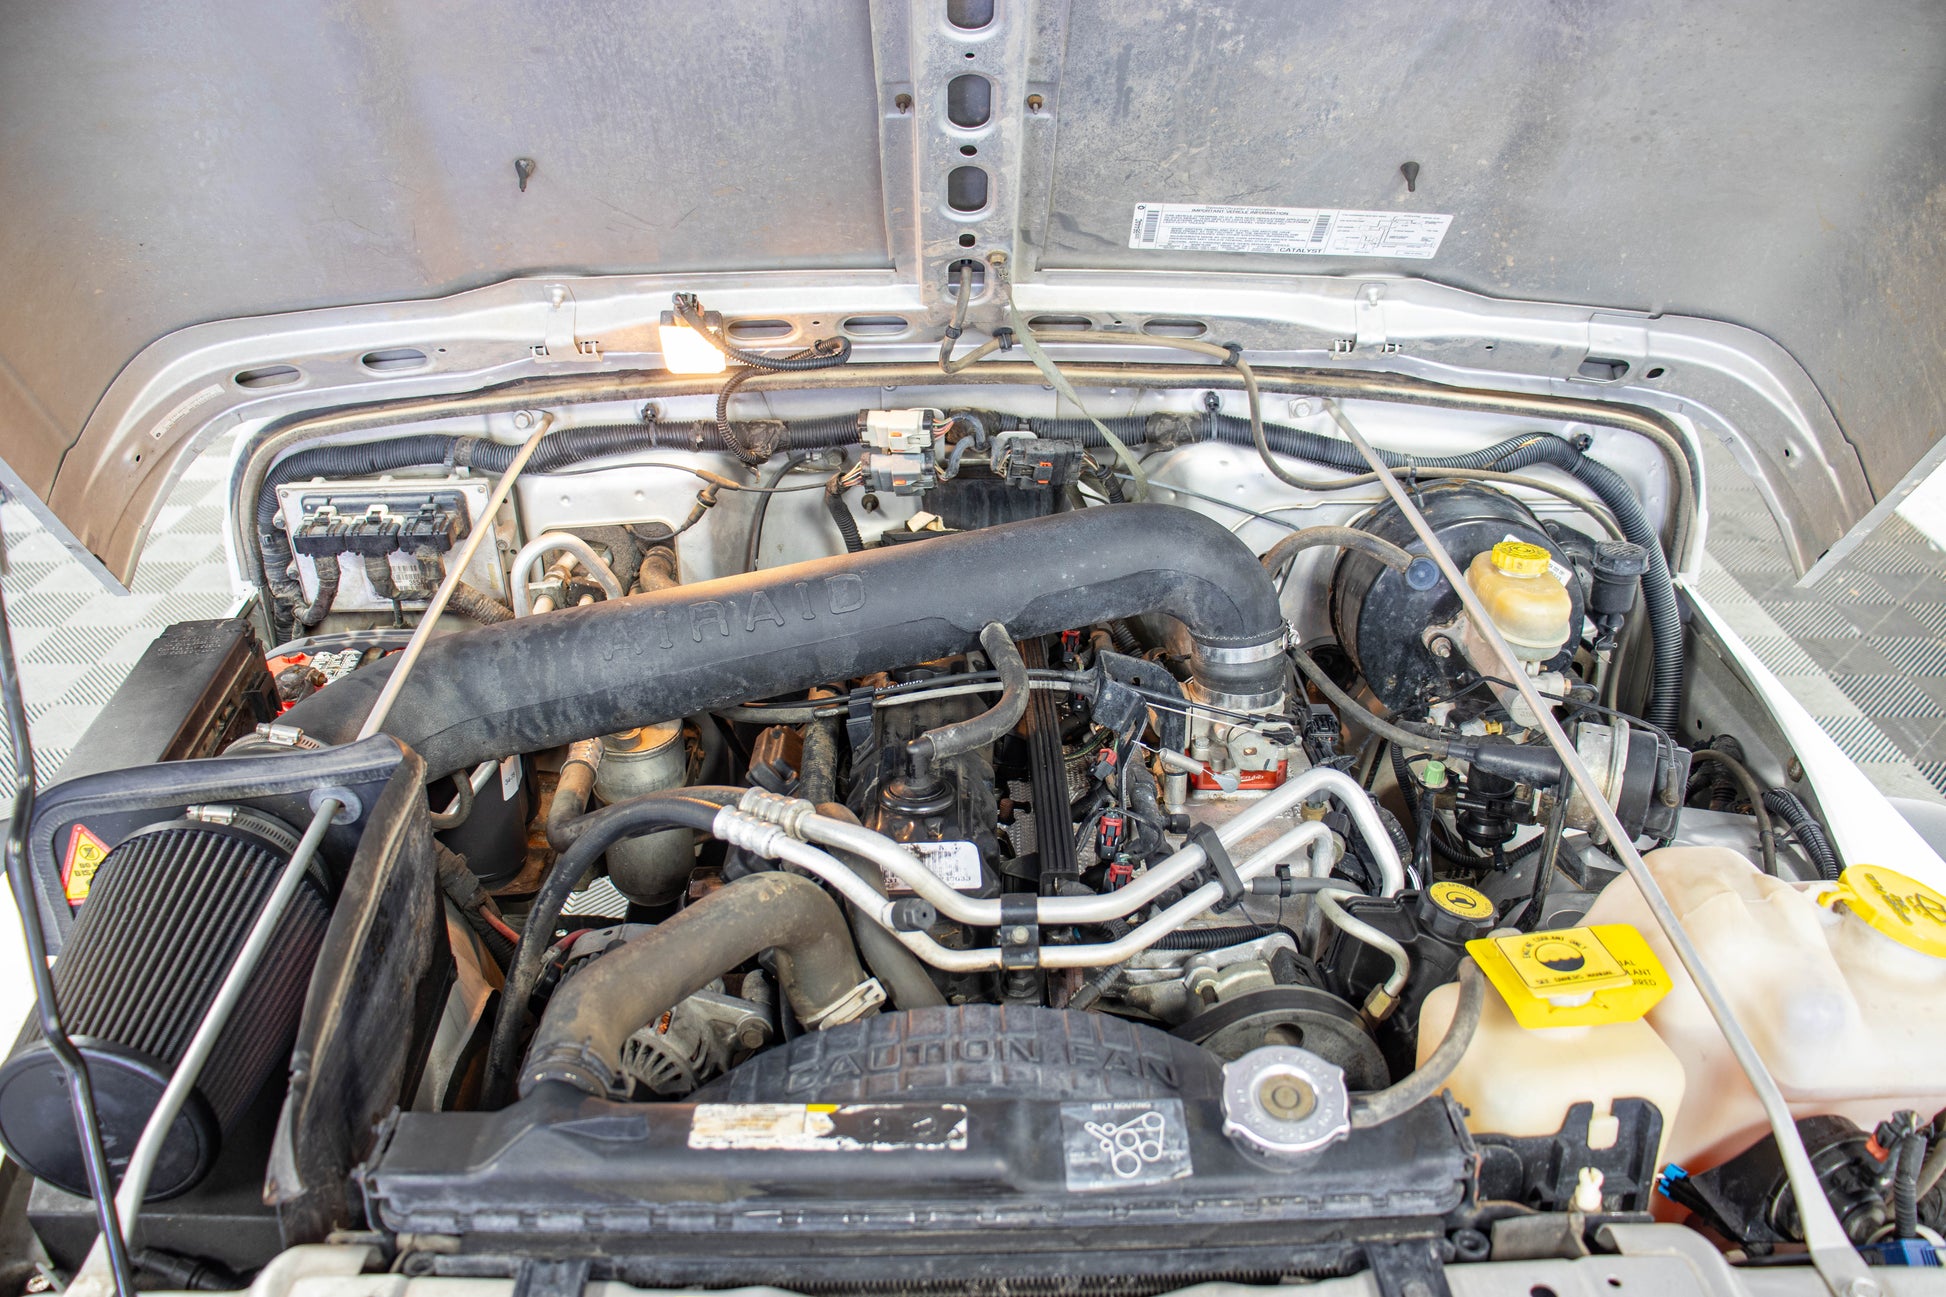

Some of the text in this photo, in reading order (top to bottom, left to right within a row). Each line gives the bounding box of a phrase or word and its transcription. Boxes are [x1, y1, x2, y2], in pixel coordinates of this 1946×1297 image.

[602, 573, 867, 661] AIRAID
[786, 1037, 1179, 1093] CAUTION FAN
[1092, 1101, 1152, 1111] BELT ROUTING
